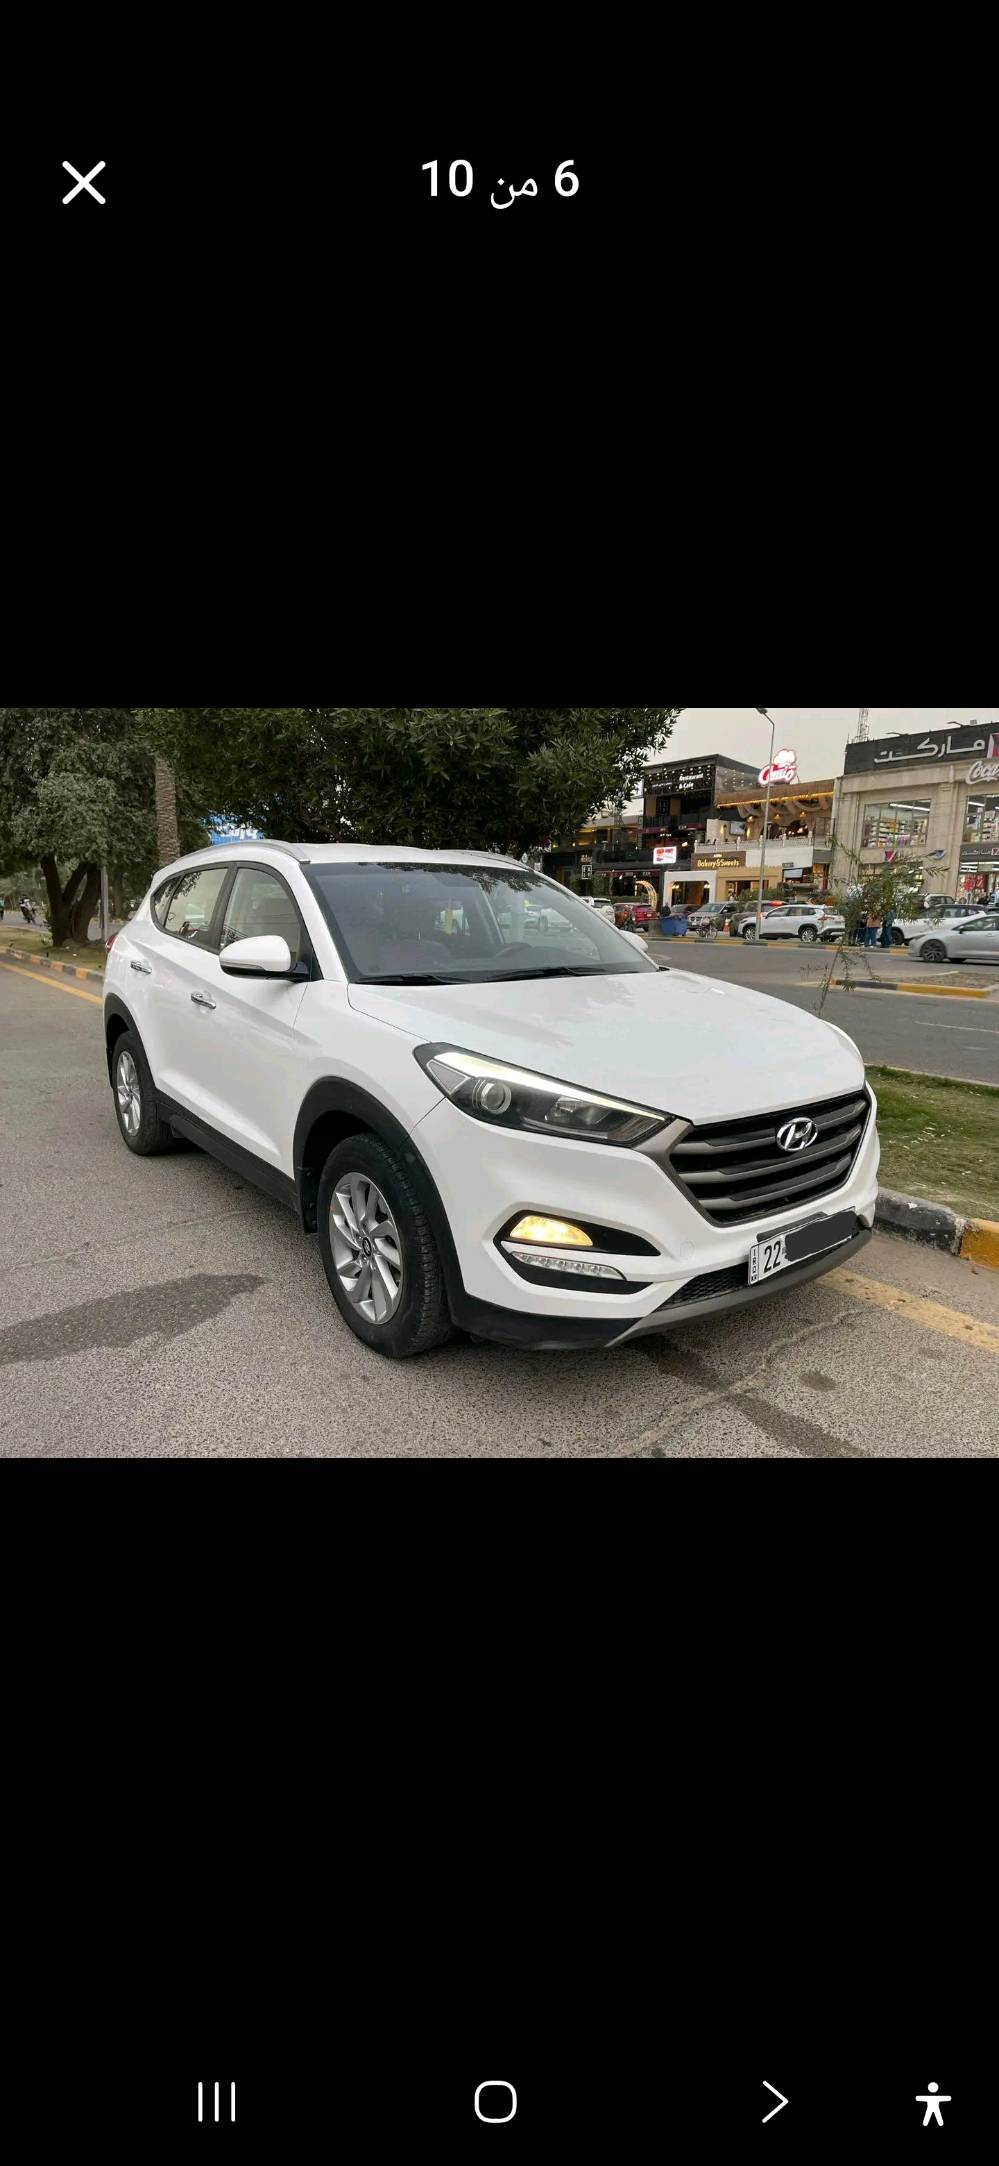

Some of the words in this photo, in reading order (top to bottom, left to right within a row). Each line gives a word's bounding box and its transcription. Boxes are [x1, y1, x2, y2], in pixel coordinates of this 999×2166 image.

[874, 736, 985, 763] ماركت
[679, 773, 704, 781] Restaurant
[764, 1241, 781, 1273] 22
